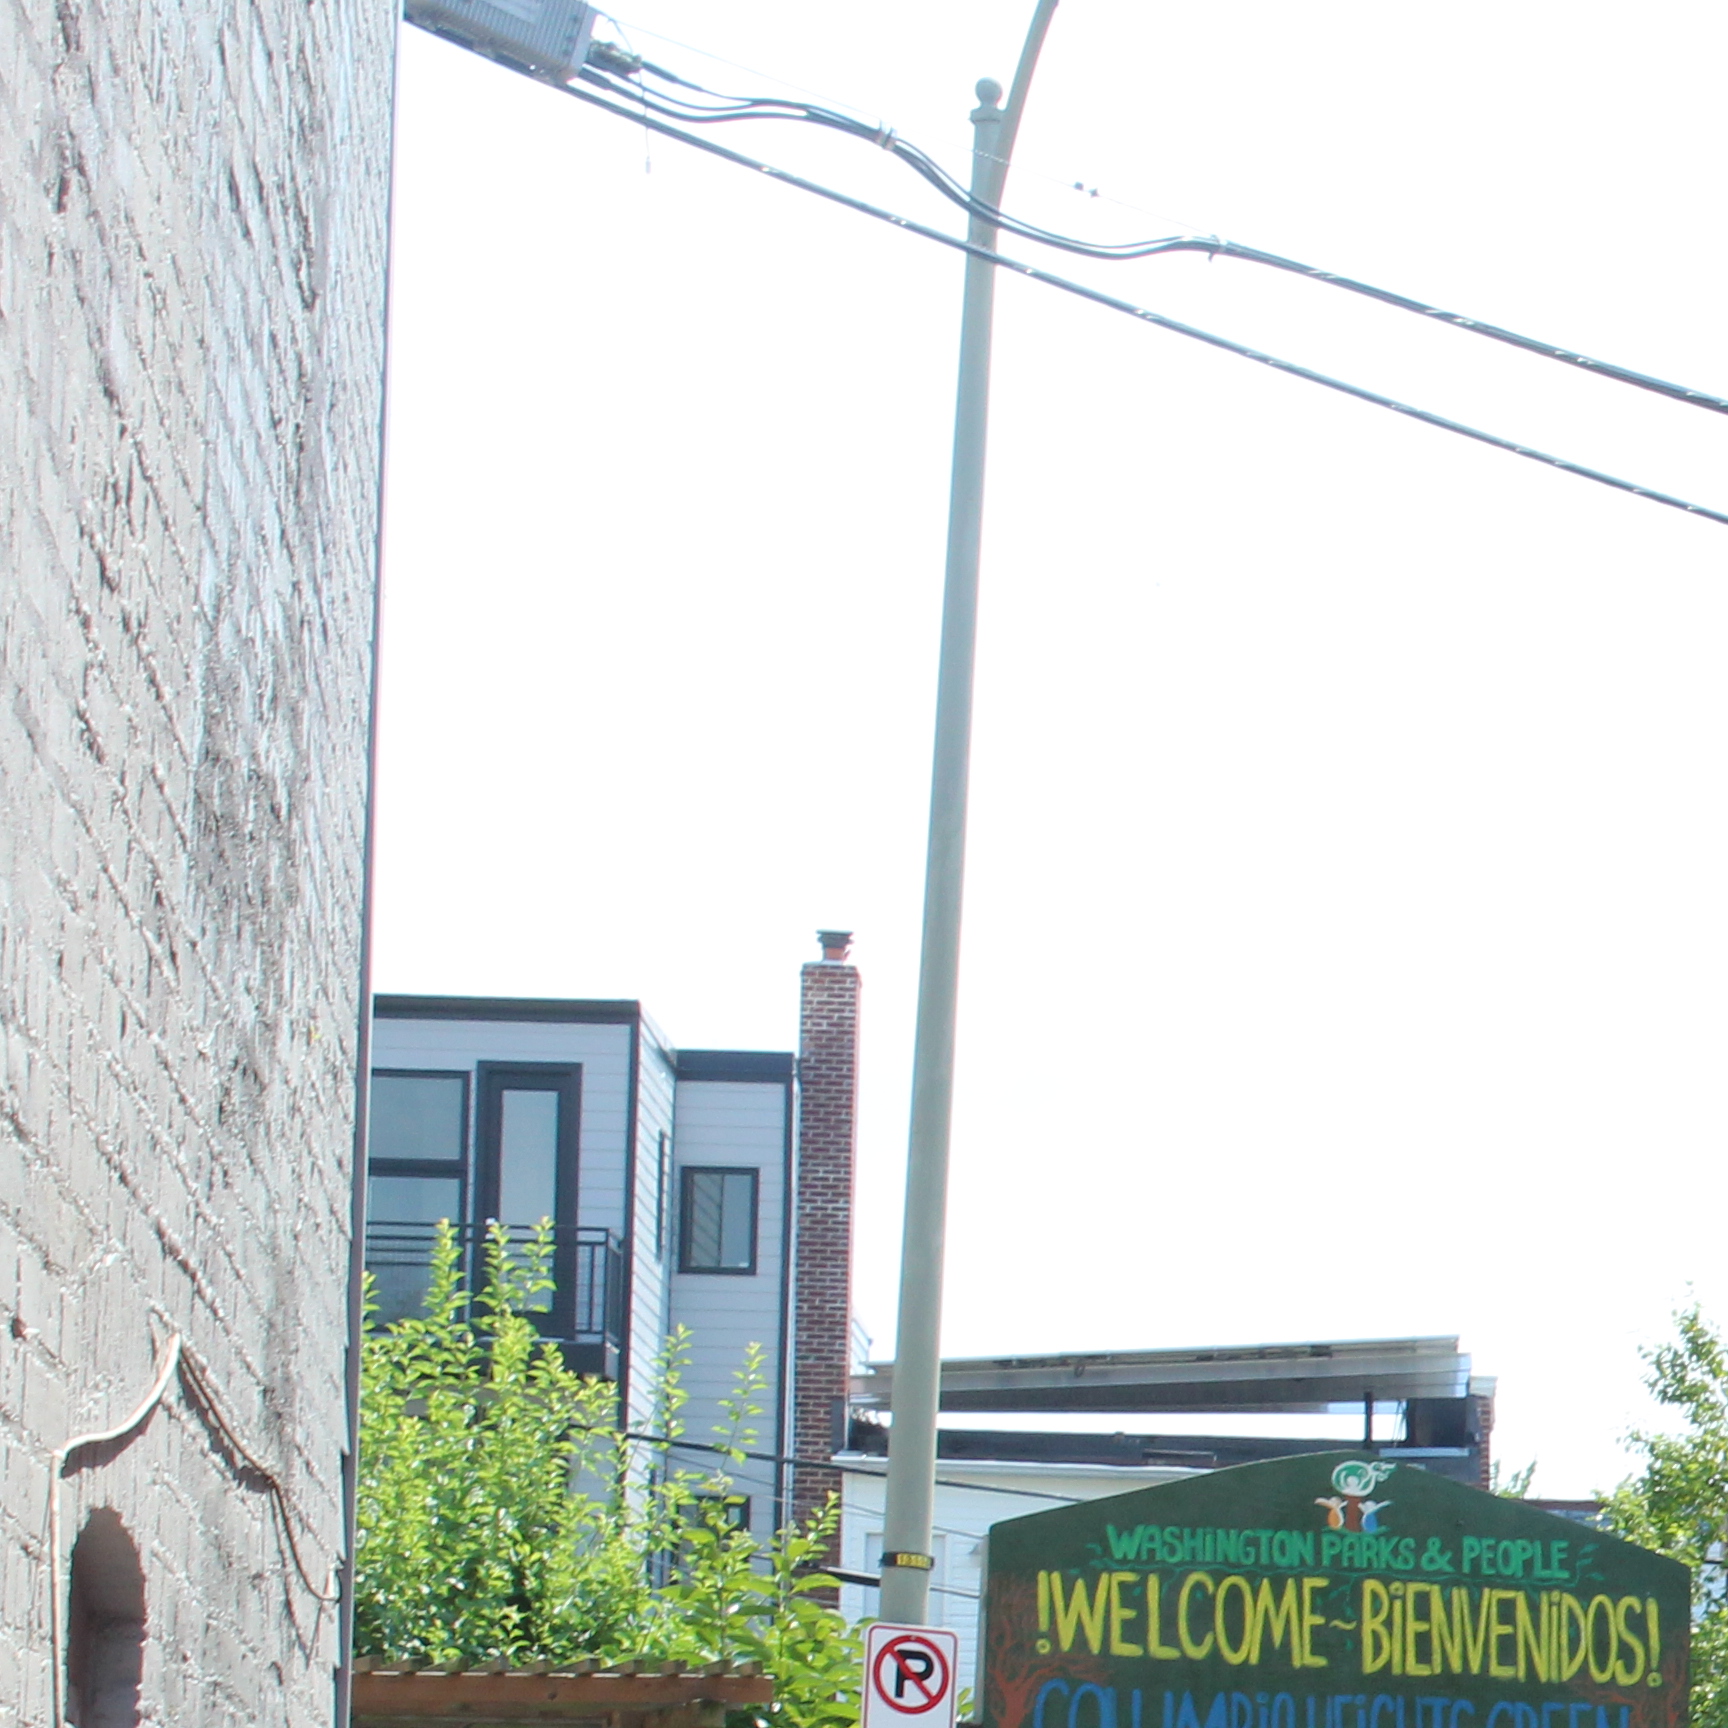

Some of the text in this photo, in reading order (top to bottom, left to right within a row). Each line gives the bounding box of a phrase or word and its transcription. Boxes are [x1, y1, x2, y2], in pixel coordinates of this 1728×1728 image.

[1105, 1523, 1570, 1579] WASHINGTON PARKS & PEOPLE
